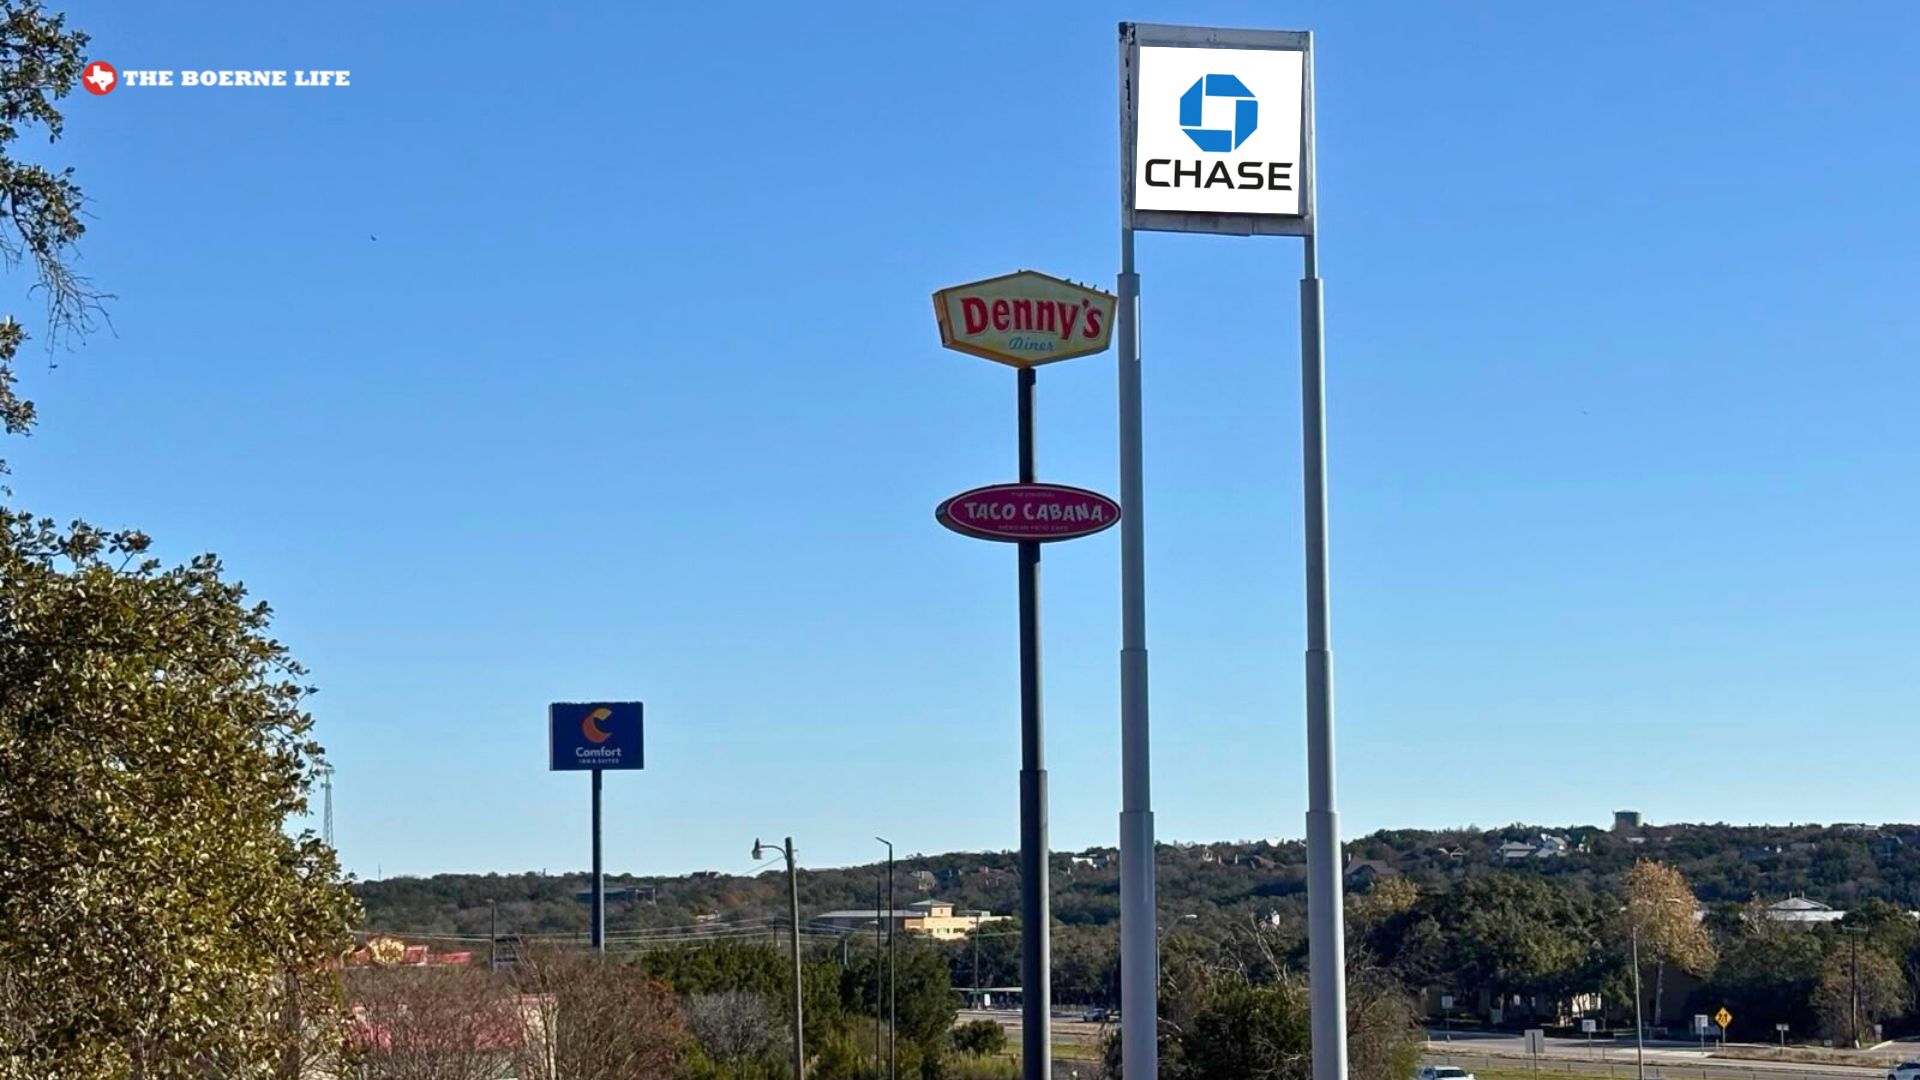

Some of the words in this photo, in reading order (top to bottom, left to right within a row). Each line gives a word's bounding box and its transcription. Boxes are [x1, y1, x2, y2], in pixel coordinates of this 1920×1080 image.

[1145, 158, 1293, 191] CHASE
[960, 297, 1103, 341] Denny's
[1008, 337, 1056, 350] Diner
[964, 502, 1016, 520] TACO
[1023, 502, 1104, 522] CABANA
[576, 746, 622, 757] Comfort
